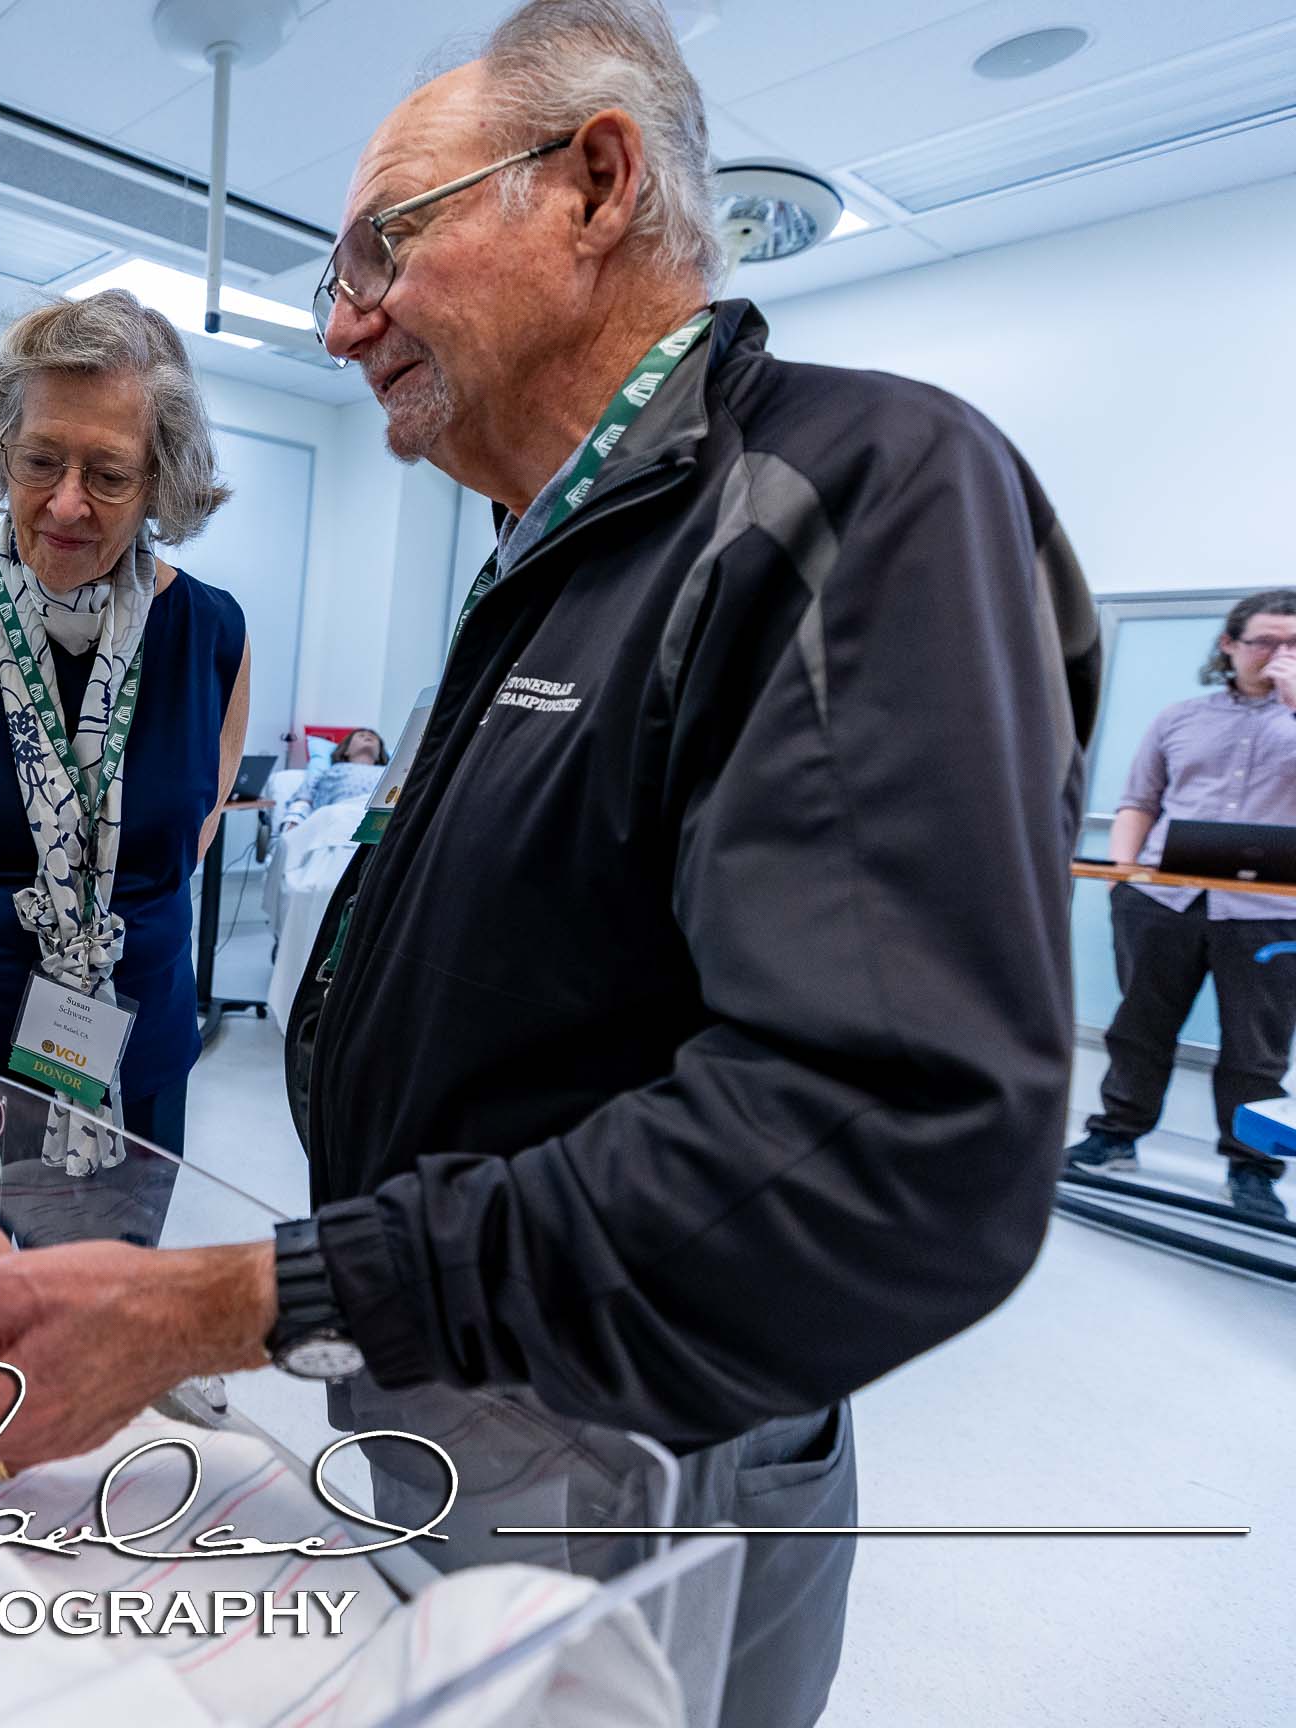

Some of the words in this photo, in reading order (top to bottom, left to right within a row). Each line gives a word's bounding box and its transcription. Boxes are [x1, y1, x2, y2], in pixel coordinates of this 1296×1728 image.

[58, 1004, 94, 1024] Schwartz
[65, 996, 91, 1012] Susan
[55, 1043, 88, 1068] VCU
[33, 1060, 83, 1090] DONOR
